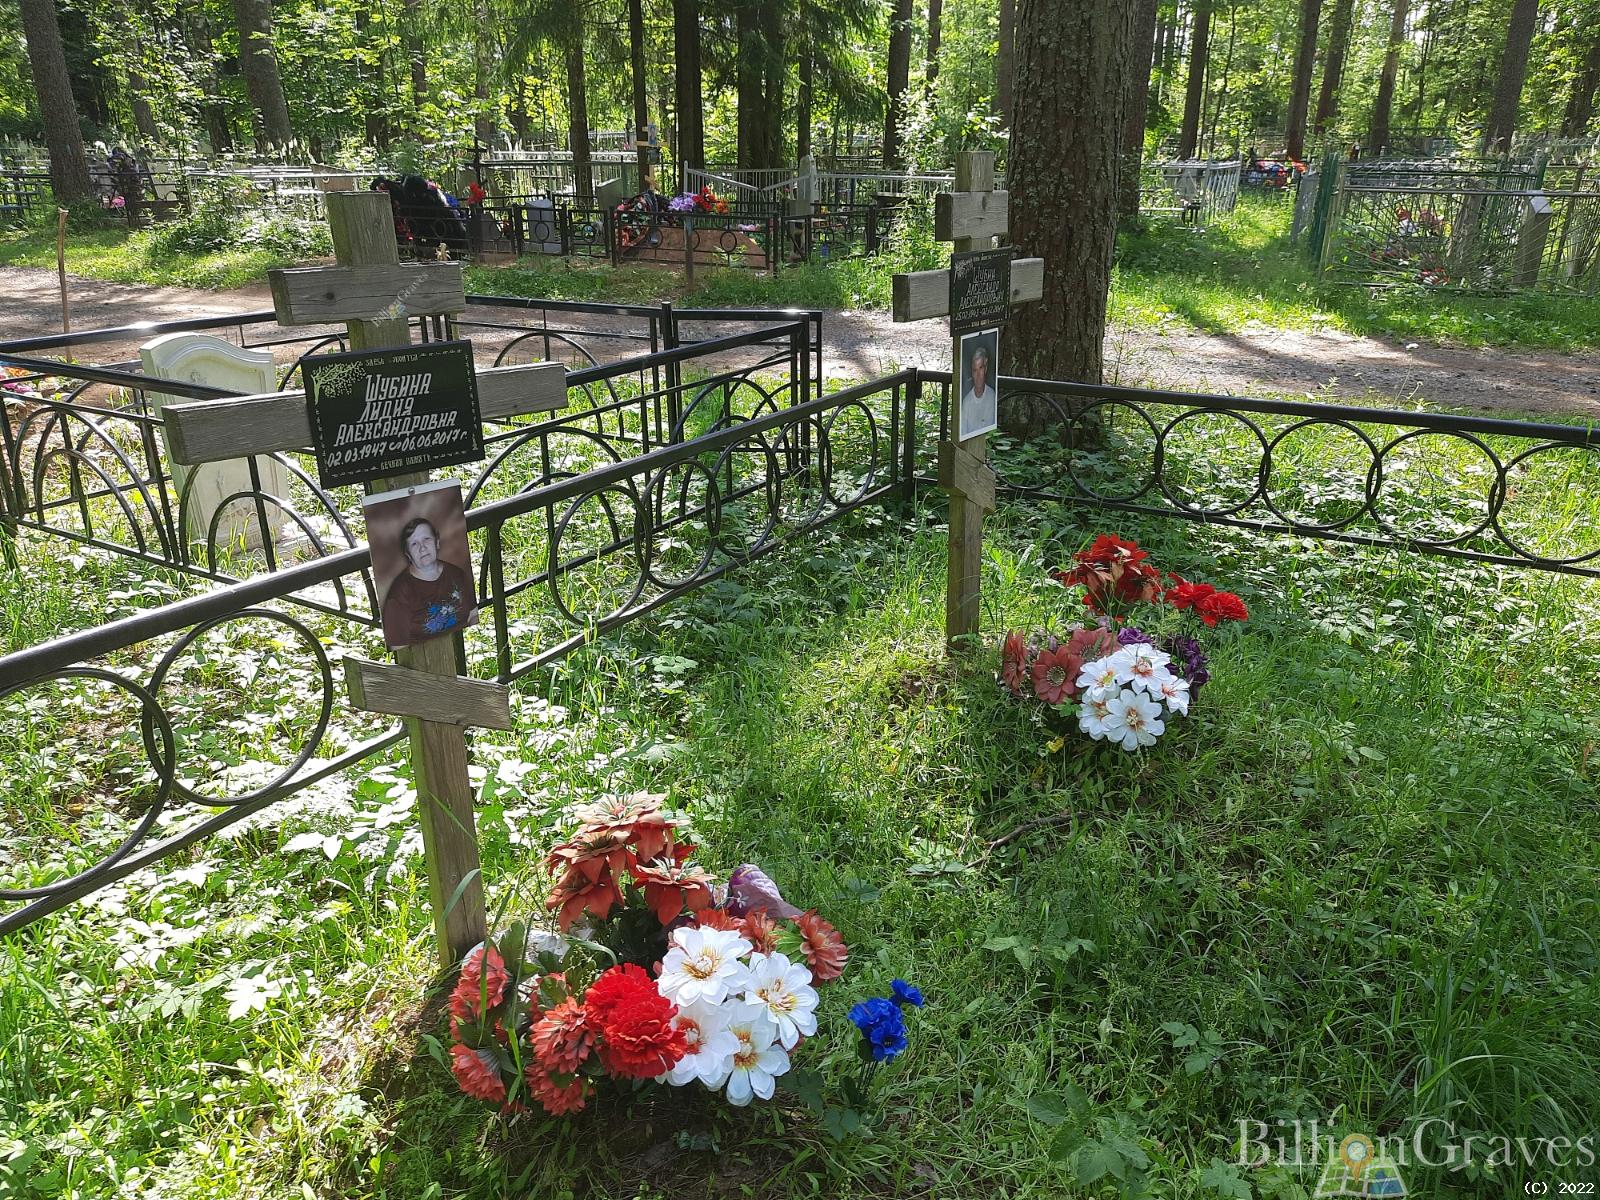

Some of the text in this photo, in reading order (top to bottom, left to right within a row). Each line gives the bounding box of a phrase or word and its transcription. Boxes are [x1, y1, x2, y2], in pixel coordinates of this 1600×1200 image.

[365, 373, 433, 402] ШУБИНА
[356, 396, 415, 424] ЛИДИЯ
[333, 410, 458, 447] АЛЕКСАНДРОВНА
[326, 441, 386, 468] 02.03.1947
